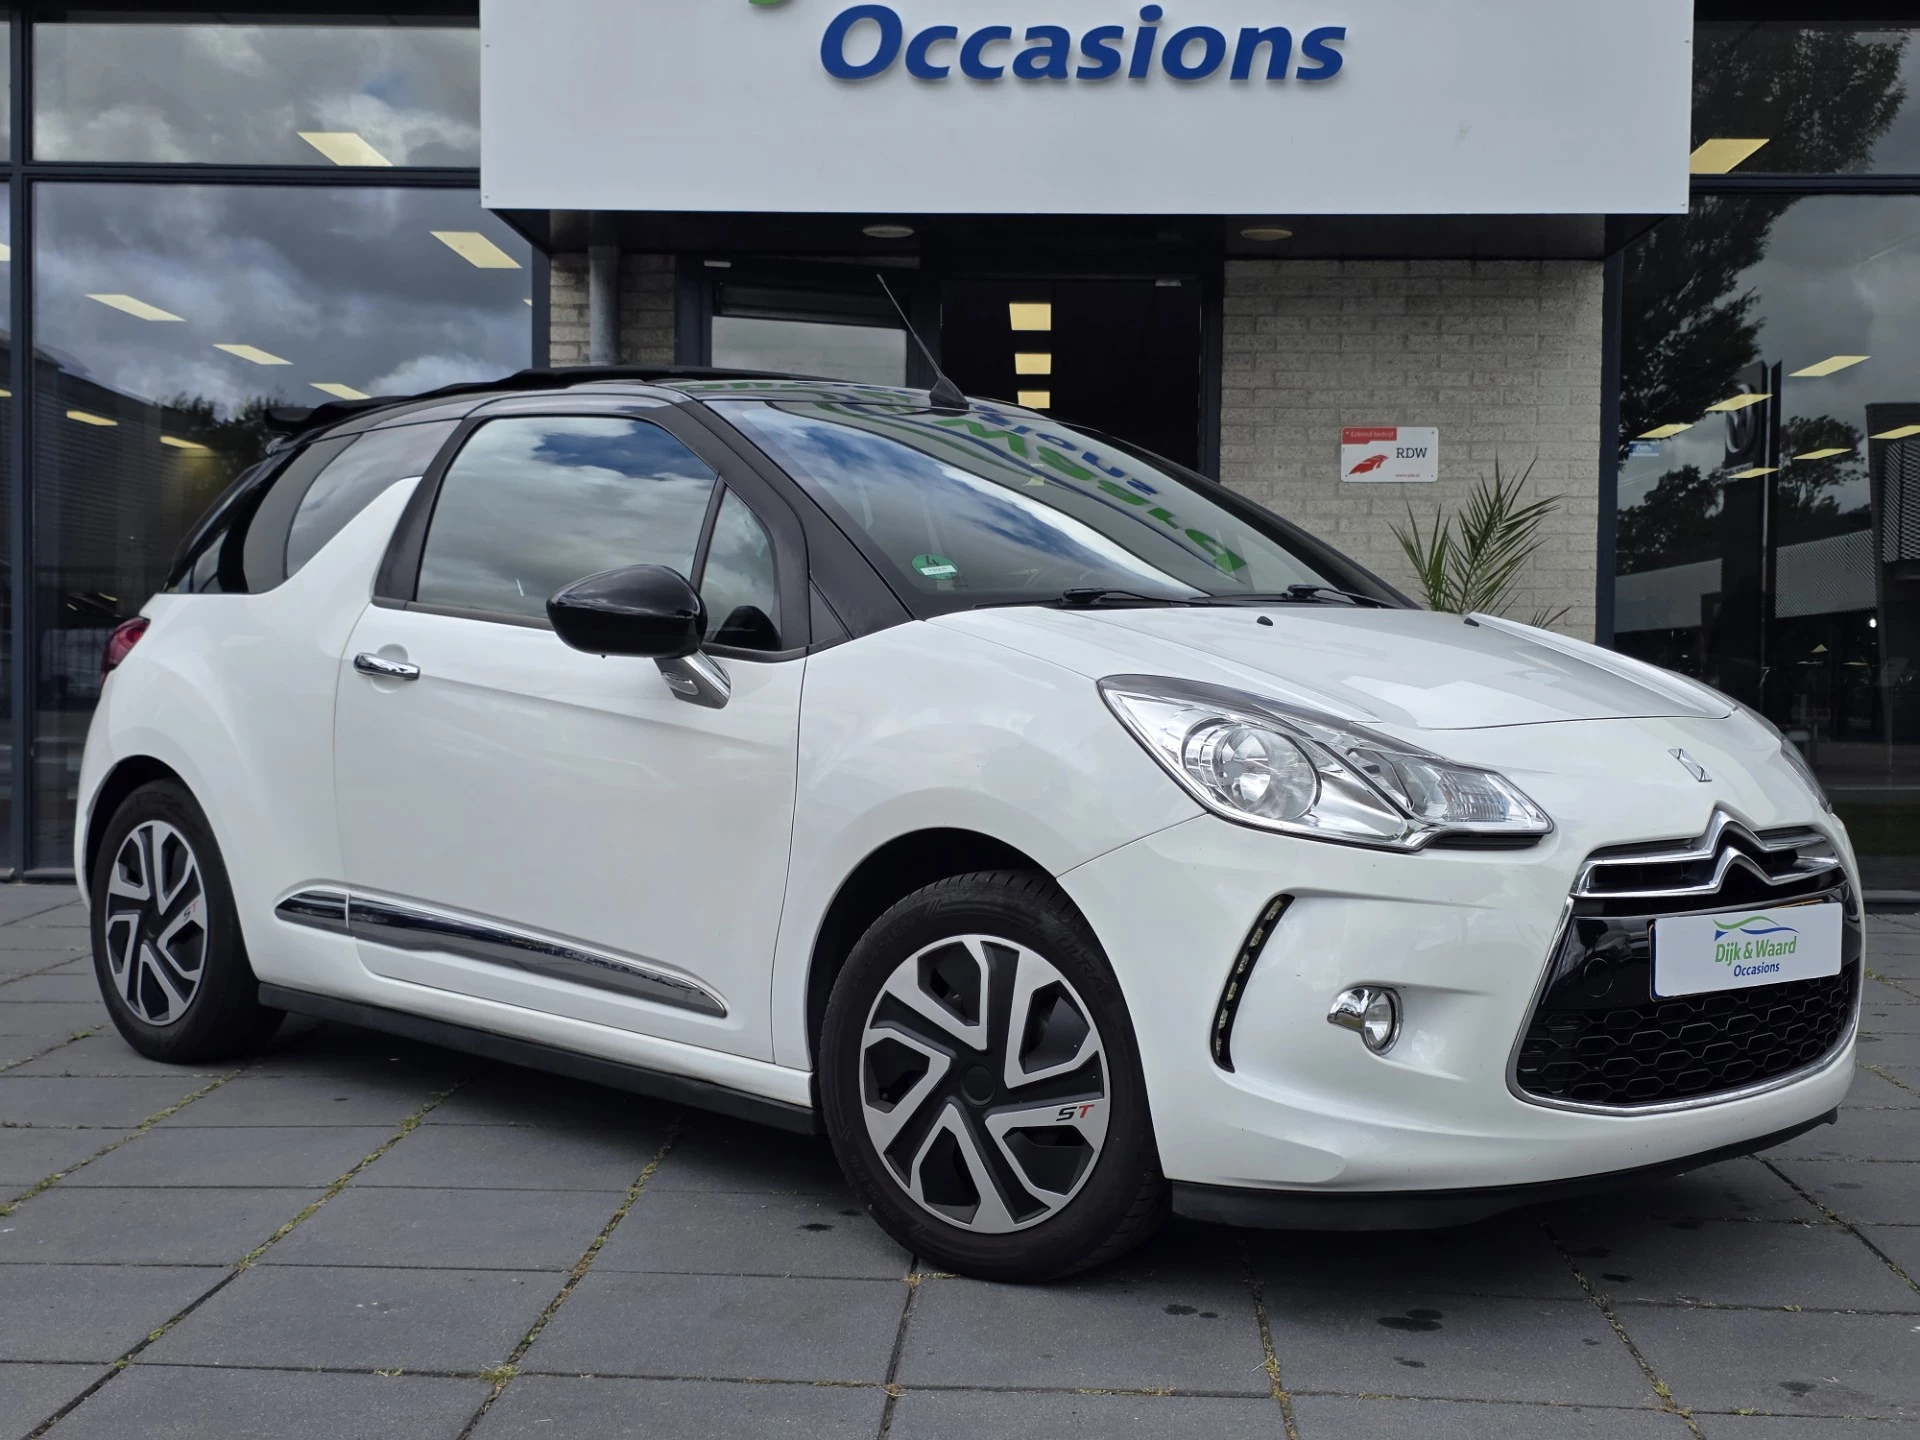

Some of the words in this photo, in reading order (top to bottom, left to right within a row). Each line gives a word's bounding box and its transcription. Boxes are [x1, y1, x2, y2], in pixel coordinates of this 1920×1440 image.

[820, 4, 1346, 80] Occasions
[1396, 447, 1428, 458] RDW
[1715, 943, 1740, 966] Dijk
[1744, 942, 1753, 959] &
[1756, 936, 1797, 958] Waard
[1734, 962, 1780, 977] Occasions
[1056, 1103, 1095, 1121] ST
